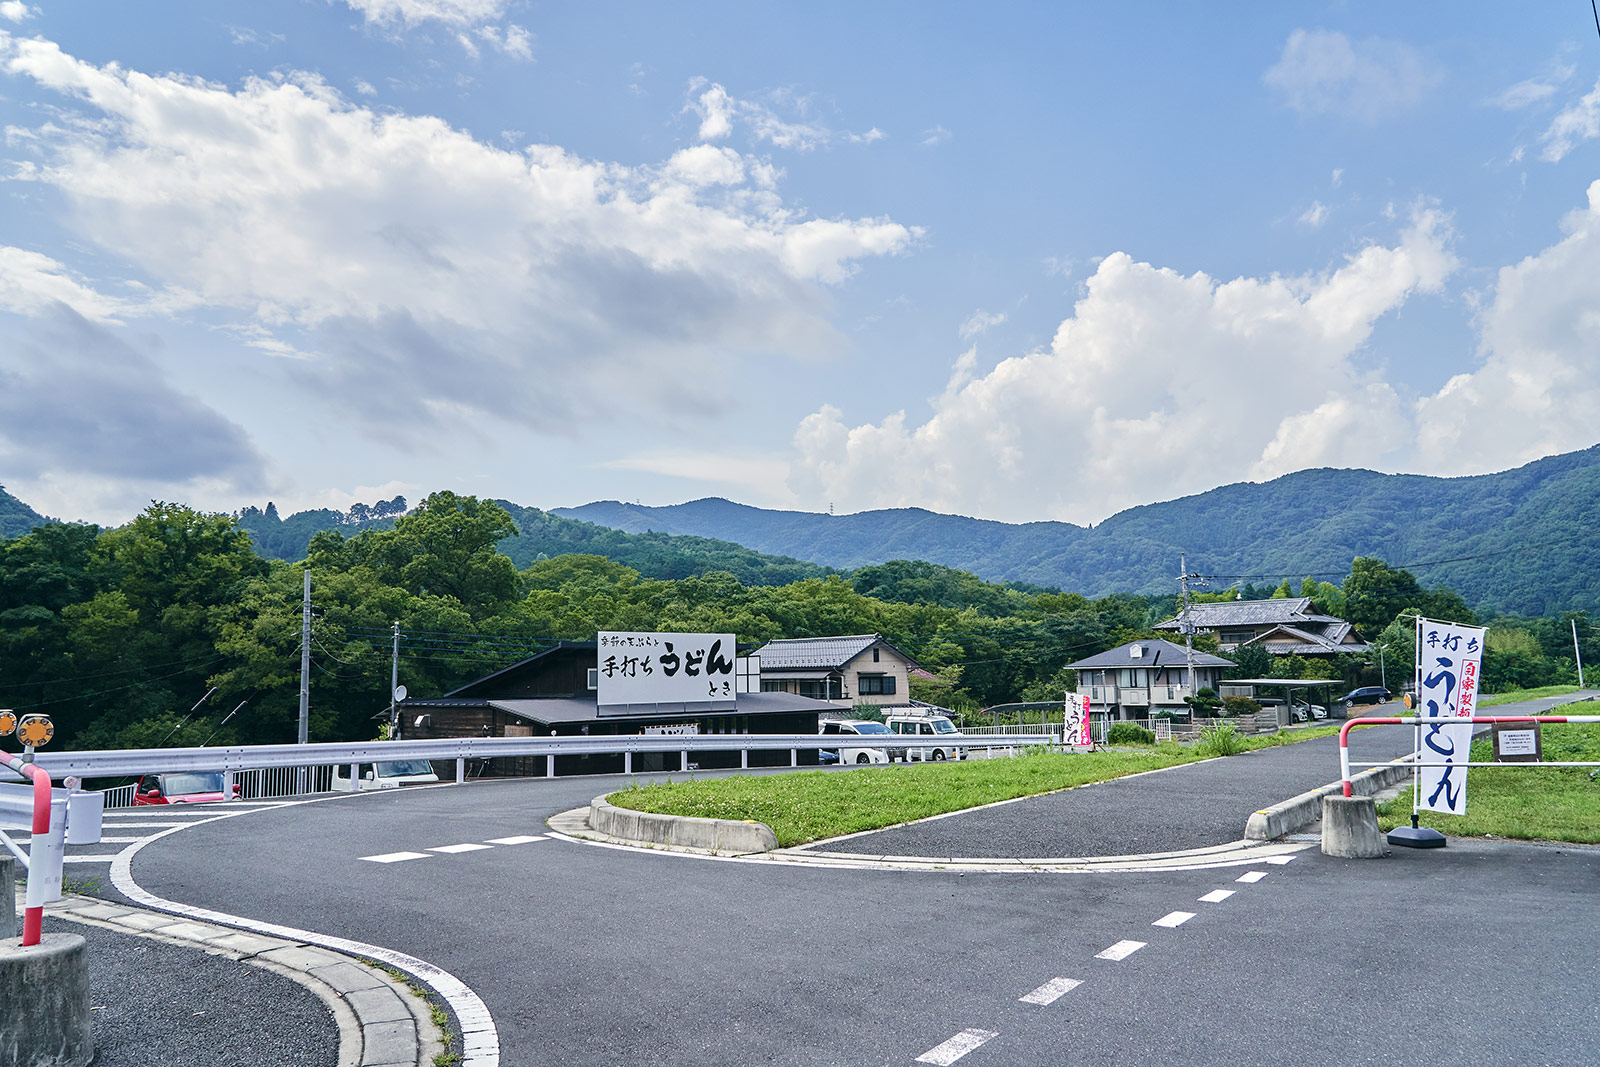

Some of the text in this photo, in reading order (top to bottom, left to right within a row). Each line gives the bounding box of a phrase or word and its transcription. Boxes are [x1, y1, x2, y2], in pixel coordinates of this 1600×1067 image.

[1426, 630, 1480, 655] 手打ち
[708, 681, 731, 697] とき
[1423, 656, 1463, 811] うどん
